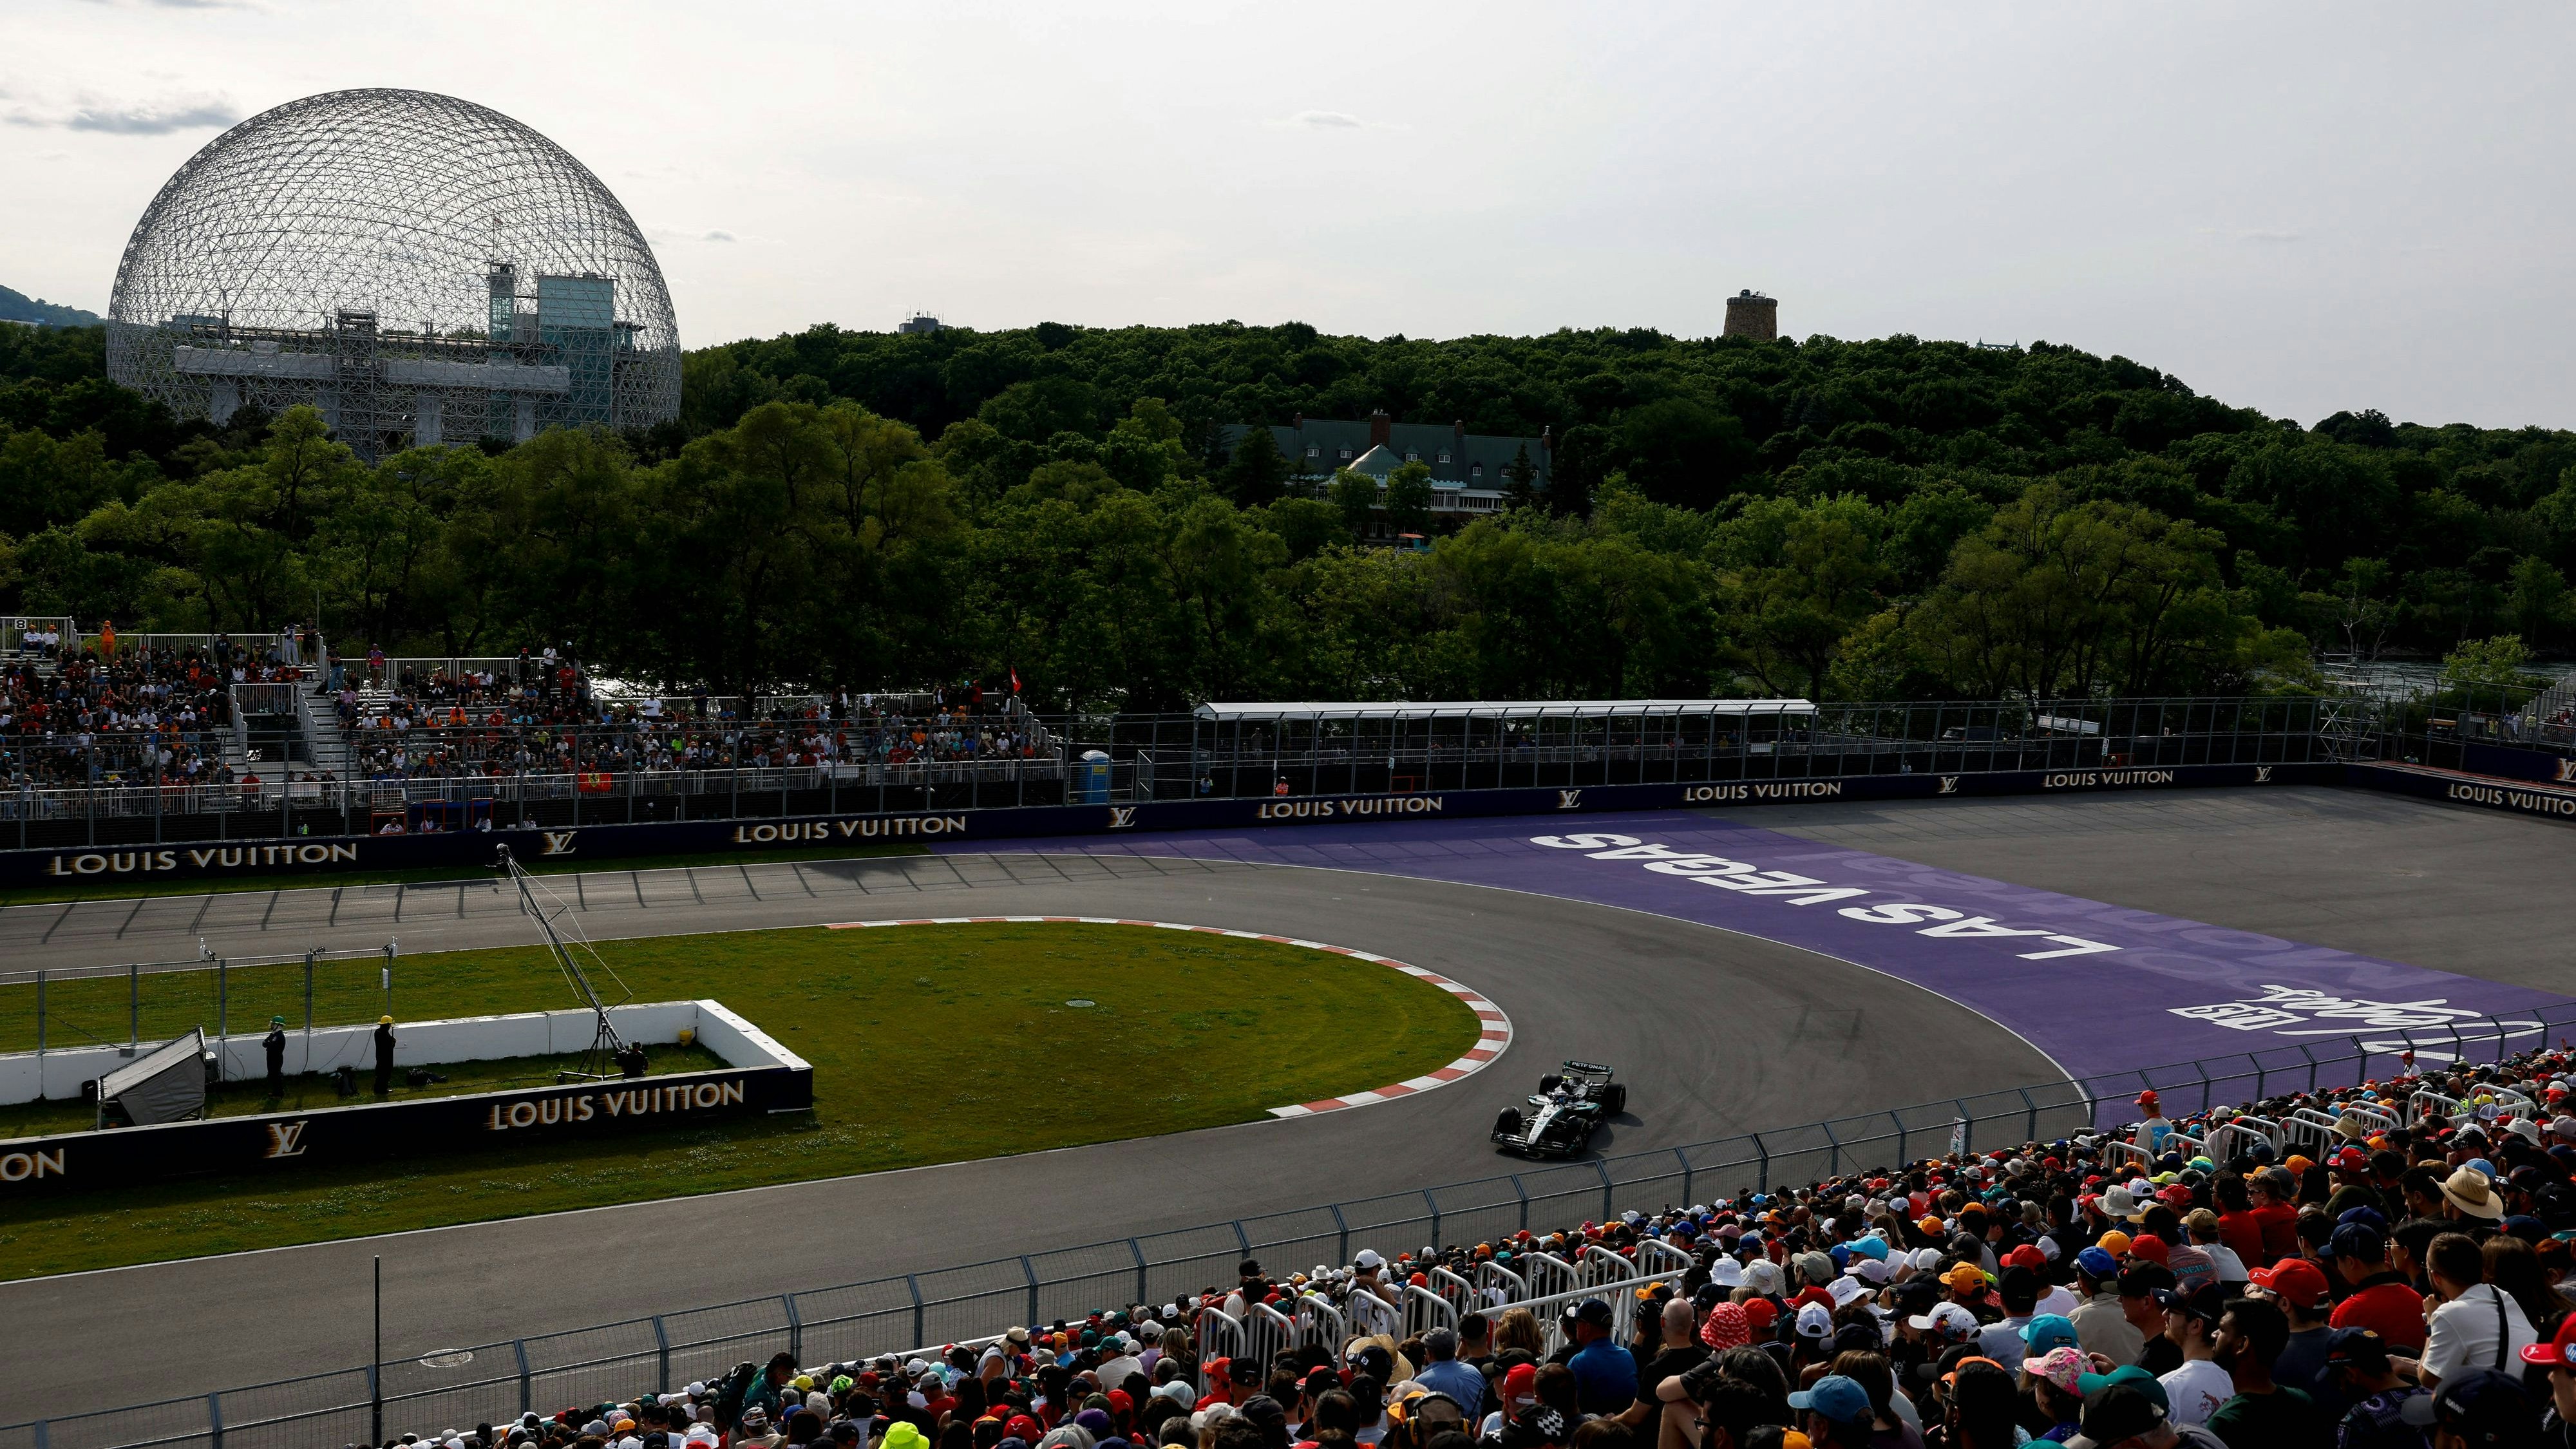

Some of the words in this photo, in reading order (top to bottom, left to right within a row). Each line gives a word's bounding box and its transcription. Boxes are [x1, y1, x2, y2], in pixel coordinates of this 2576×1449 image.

[17, 620, 25, 629] 8
[1938, 776, 1959, 793] LV
[2045, 773, 2096, 787] LOUIS
[2103, 770, 2174, 784] VUITTON
[2255, 766, 2271, 782] LV
[1558, 790, 1582, 808] LV
[1687, 785, 1748, 801] LOUIS
[1756, 782, 1841, 798] VUITTON
[2450, 783, 2503, 805] LOUIS
[1110, 807, 1137, 828] LV
[1262, 800, 1334, 819] LOUIS
[1343, 797, 1442, 815] VUITTON
[739, 822, 829, 843] LOUIS
[840, 815, 966, 837] VUITTON
[542, 831, 578, 855] LV
[55, 849, 176, 875] LOUIS
[191, 843, 357, 867] VUITTON
[1530, 833, 1871, 905] VEGAS
[1837, 904, 2124, 960] LAS
[1571, 1061, 1606, 1070] PETRONAS
[493, 1095, 595, 1131] LOUIS
[606, 1080, 744, 1117] VUITTON
[269, 1121, 307, 1157] LV
[0, 1148, 64, 1181] ON
